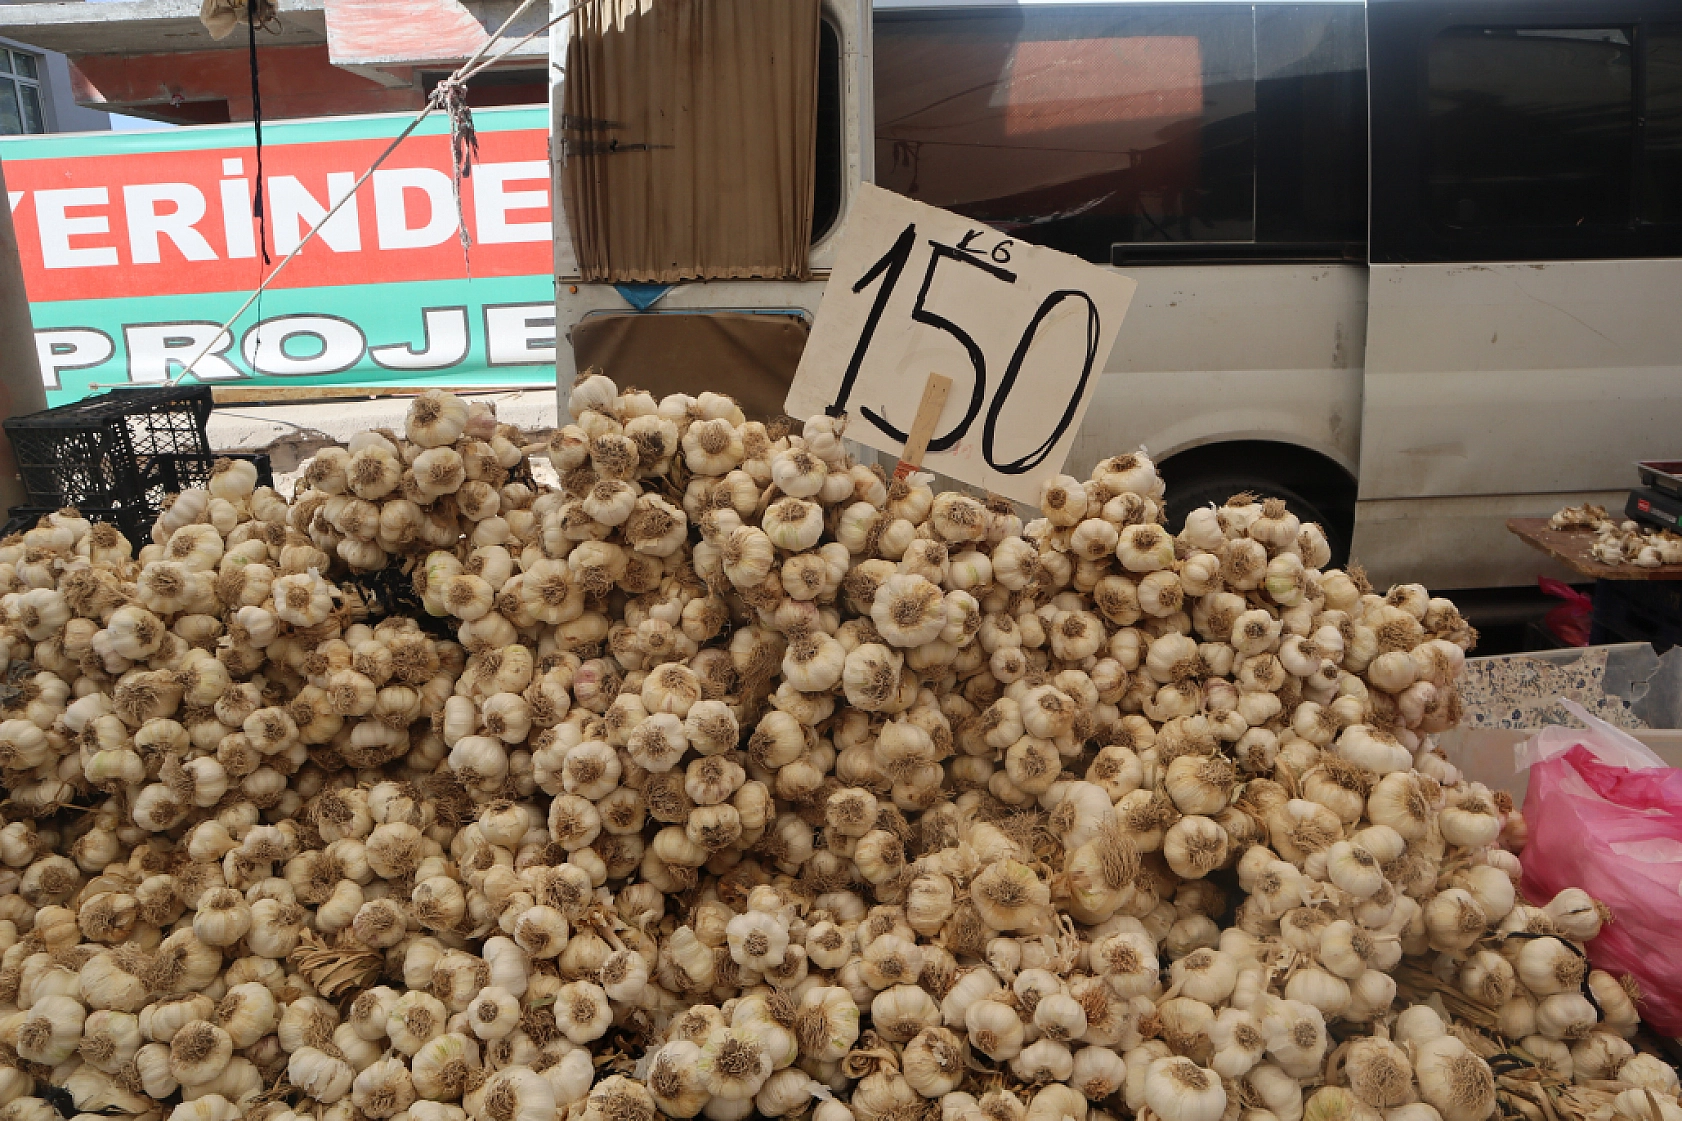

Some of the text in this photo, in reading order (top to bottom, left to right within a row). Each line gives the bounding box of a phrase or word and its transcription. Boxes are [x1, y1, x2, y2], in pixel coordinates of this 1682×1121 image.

[8, 158, 553, 269] ERİNDE
[33, 301, 556, 391] PROJE
[825, 223, 1100, 474] 150
